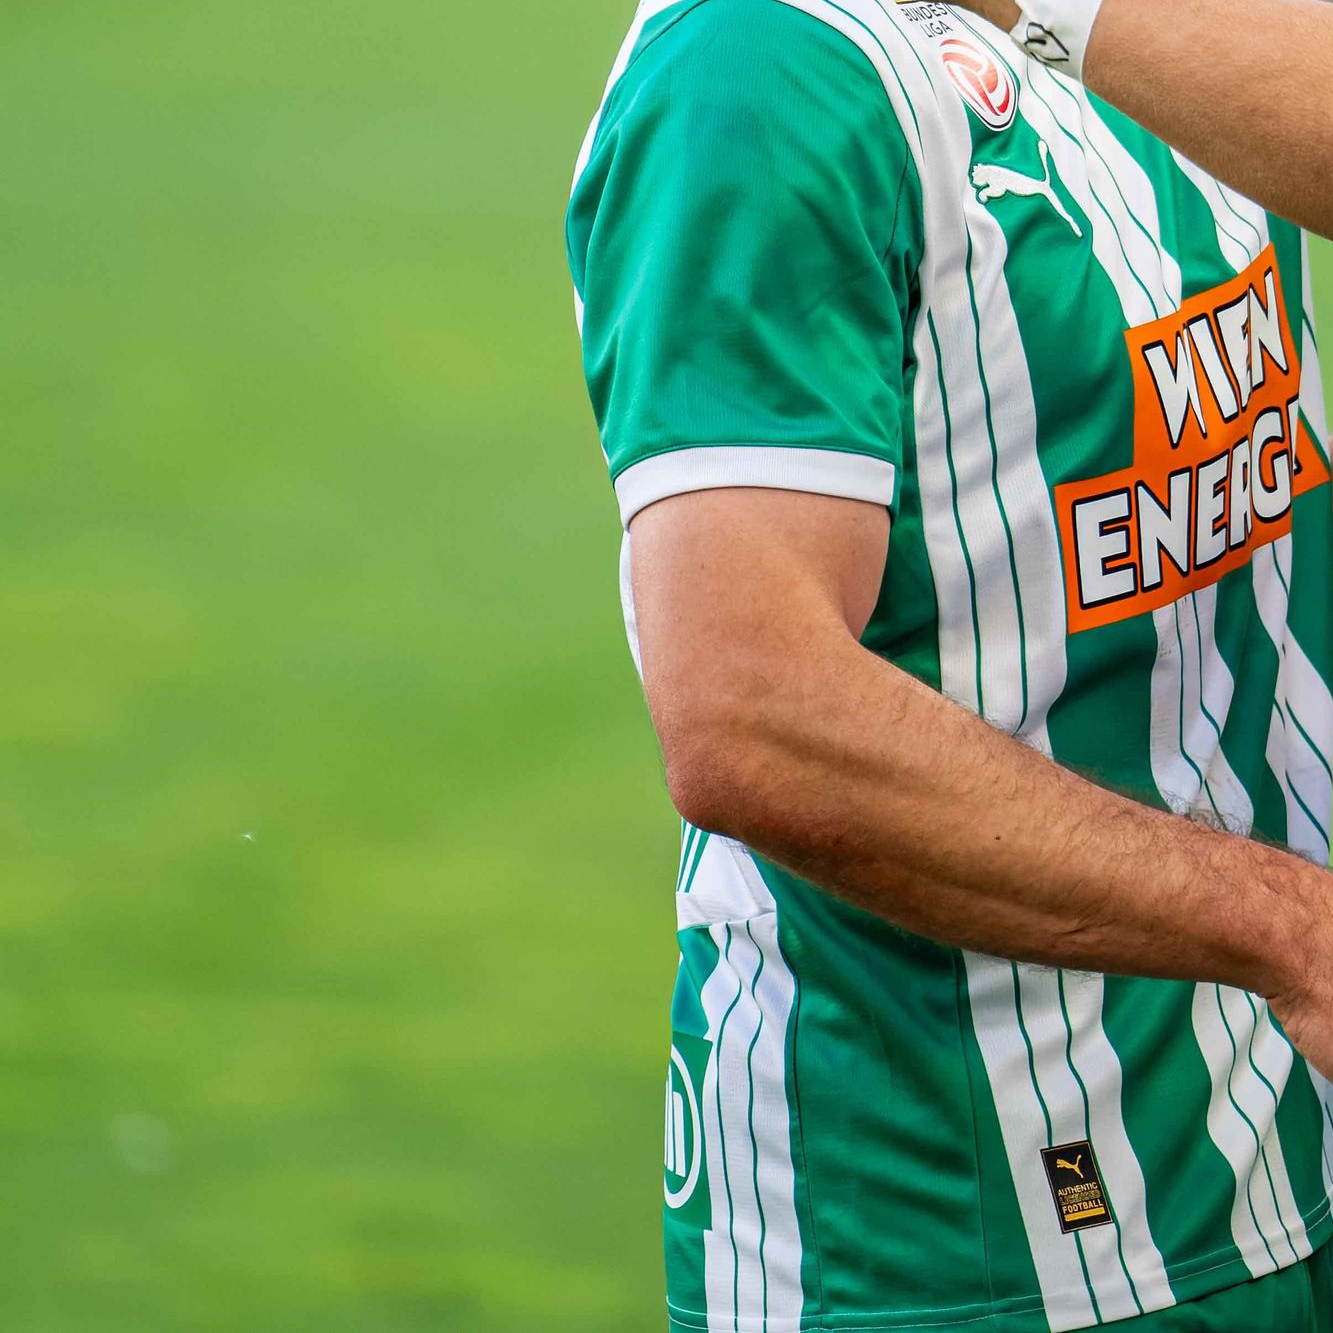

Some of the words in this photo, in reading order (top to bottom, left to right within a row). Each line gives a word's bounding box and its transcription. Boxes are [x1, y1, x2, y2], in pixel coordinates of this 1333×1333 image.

[901, 2, 948, 22] BUNDES
[920, 20, 954, 38] LIGA
[1142, 266, 1289, 449] WIEN
[1058, 1182, 1098, 1196] AUTHENTIC
[1062, 1199, 1104, 1214] FOOTBALL
